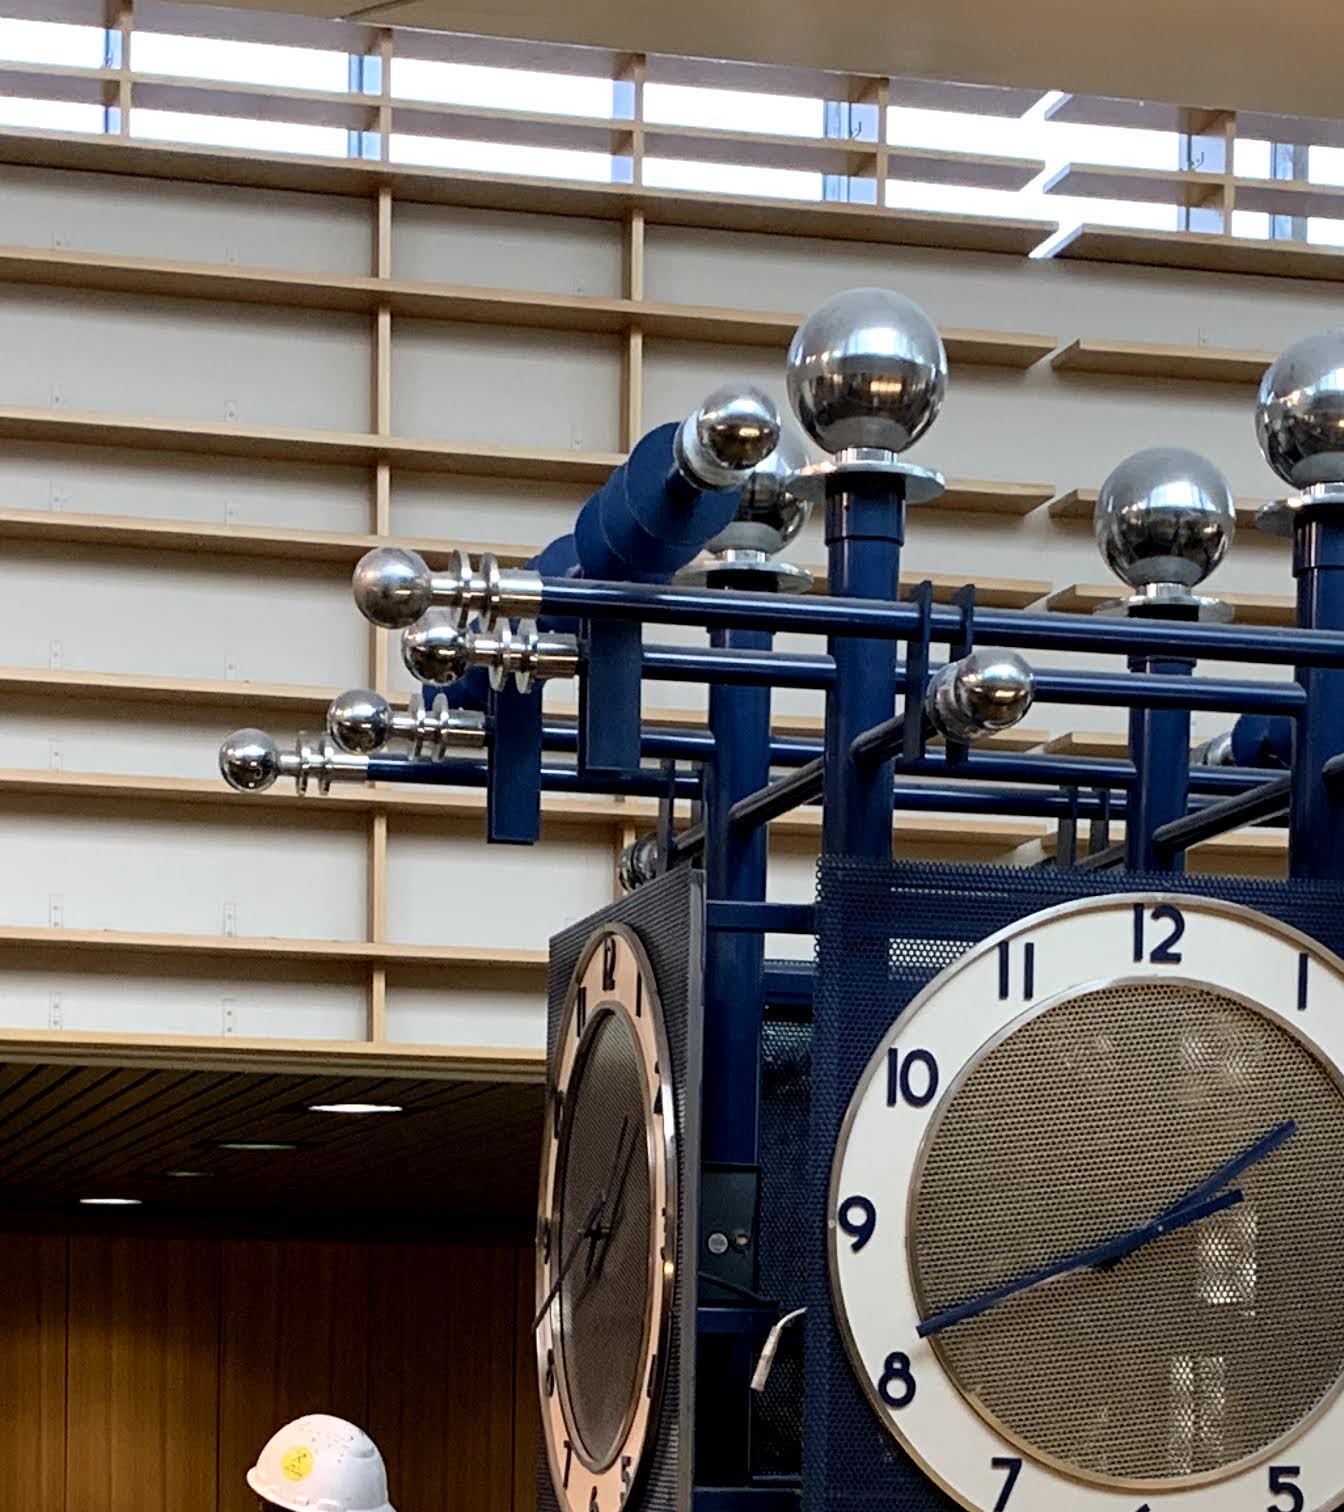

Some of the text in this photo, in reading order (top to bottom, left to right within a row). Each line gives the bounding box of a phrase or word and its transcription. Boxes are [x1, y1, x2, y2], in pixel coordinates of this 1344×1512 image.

[1133, 904, 1186, 964] 12
[997, 942, 1035, 999] 11
[1296, 953, 1309, 1009] 1
[886, 1047, 939, 1108] 10
[837, 1195, 876, 1255] 9
[877, 1351, 918, 1409] 8
